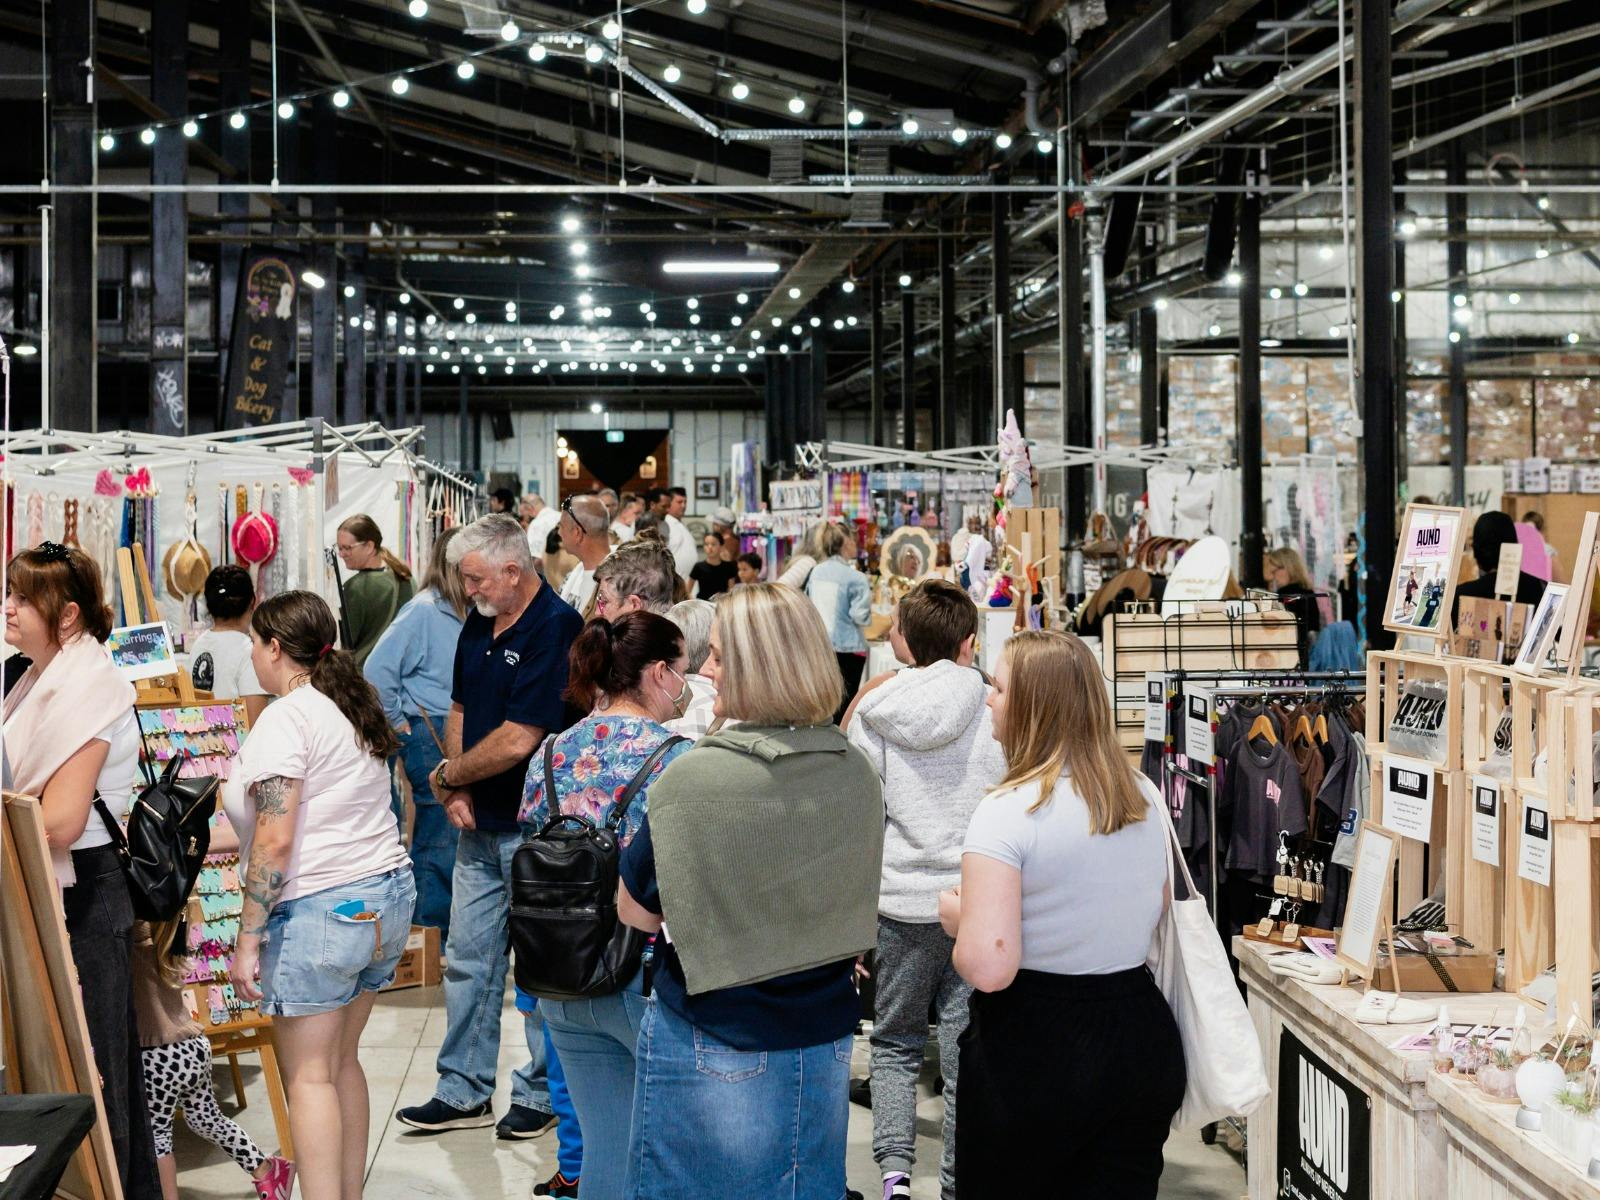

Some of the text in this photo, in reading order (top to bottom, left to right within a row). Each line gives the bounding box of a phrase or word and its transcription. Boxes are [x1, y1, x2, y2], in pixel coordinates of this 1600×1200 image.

[249, 334, 273, 352] Cat
[250, 356, 267, 371] &
[243, 375, 267, 399] Dog
[1416, 528, 1441, 547] AUND
[1397, 770, 1420, 789] AUND
[1298, 1053, 1350, 1193] AUND
